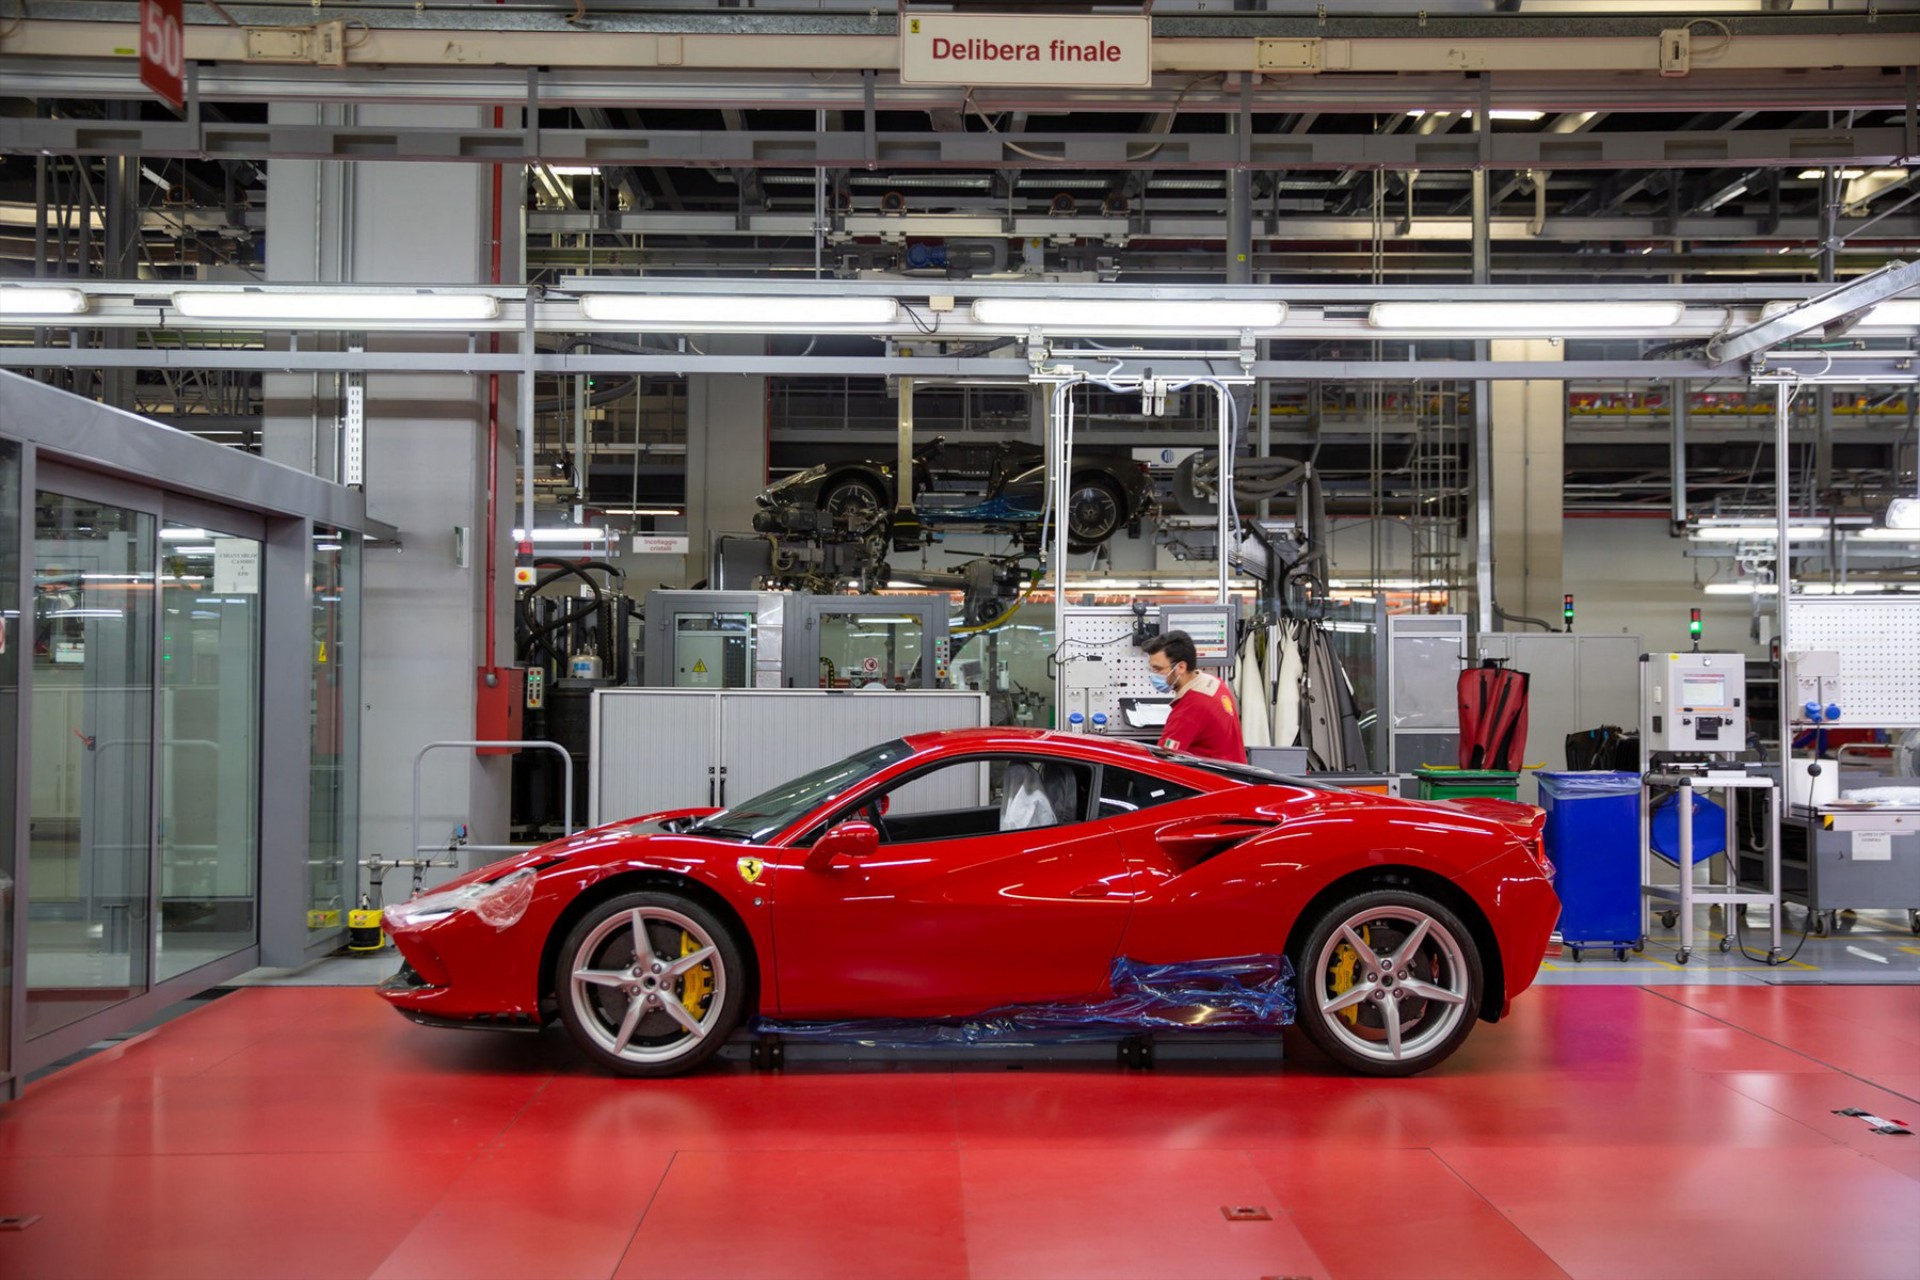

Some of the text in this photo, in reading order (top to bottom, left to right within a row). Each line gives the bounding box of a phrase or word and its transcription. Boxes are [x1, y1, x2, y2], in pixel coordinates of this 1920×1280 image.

[147, 0, 180, 77] 50
[932, 38, 1121, 62] Delibera finale
